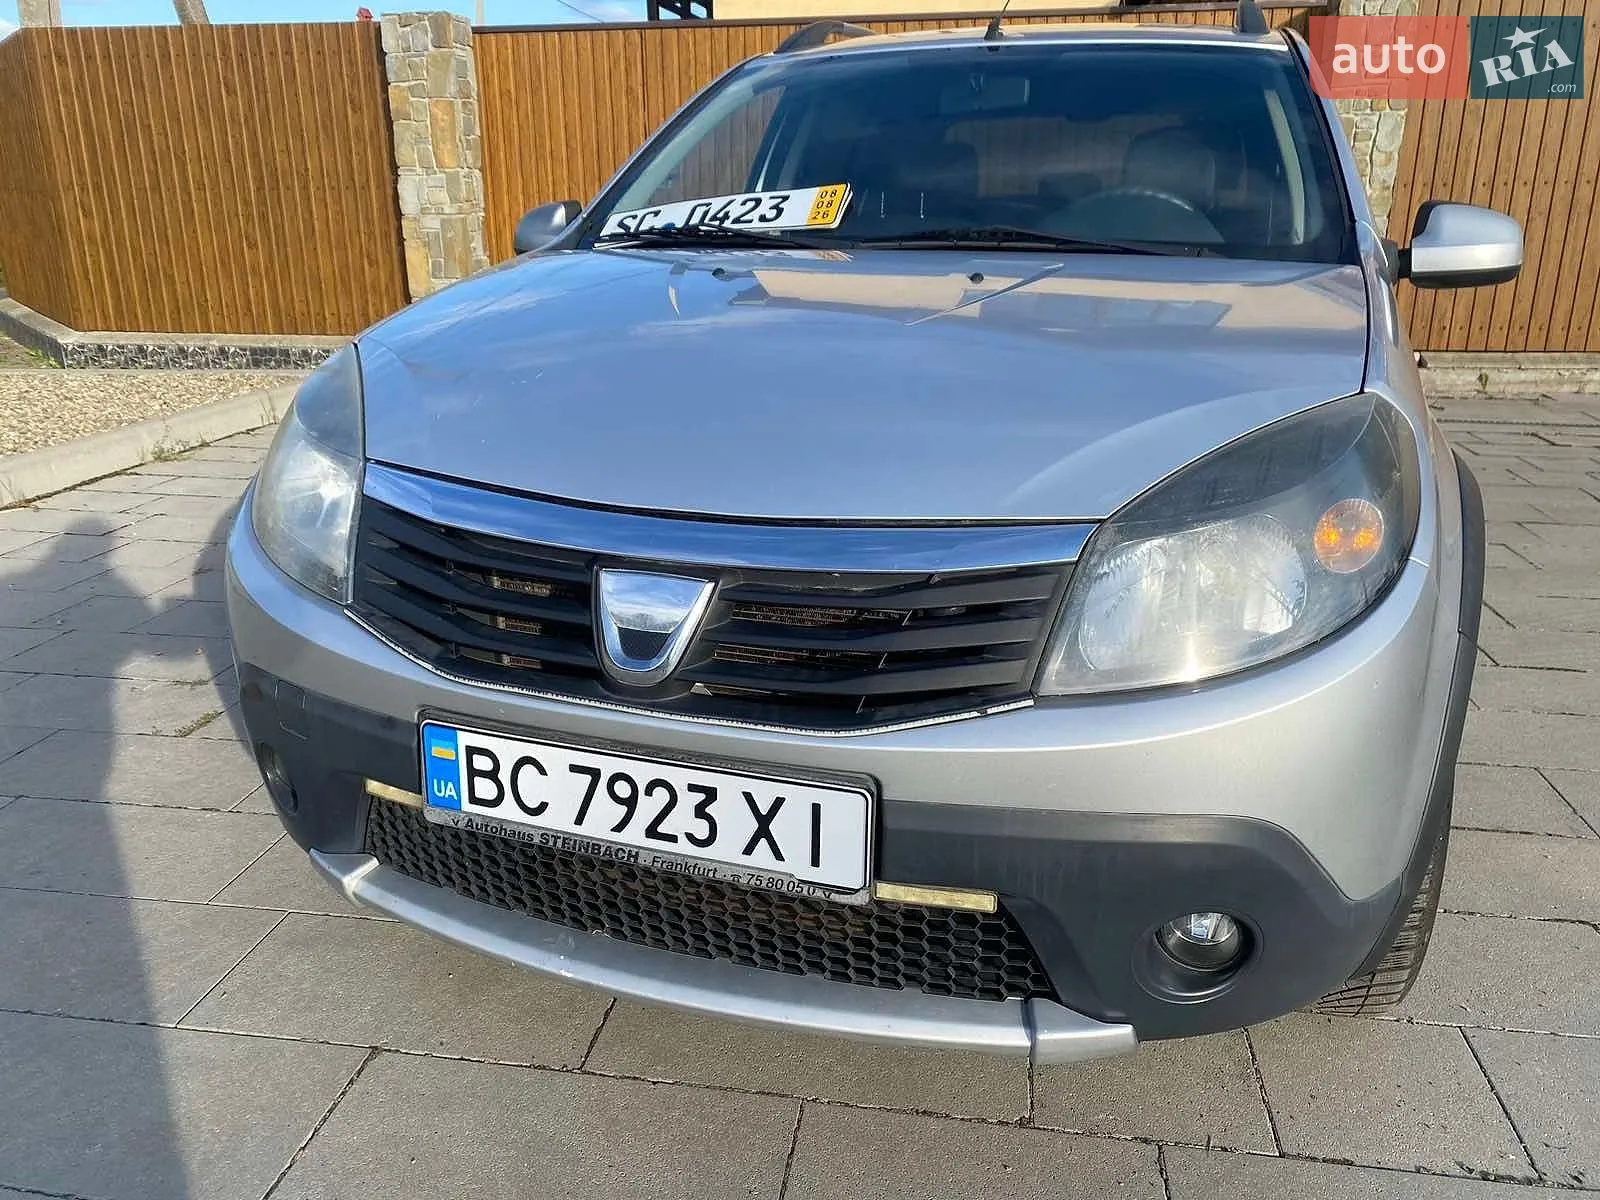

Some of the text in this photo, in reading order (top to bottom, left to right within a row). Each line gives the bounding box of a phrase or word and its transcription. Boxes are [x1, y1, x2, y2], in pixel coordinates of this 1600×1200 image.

[816, 200, 833, 209] 08
[820, 189, 837, 199] 08
[433, 778, 458, 800] UA
[464, 745, 821, 868] BC 7923 XI
[464, 817, 535, 842] Autohaus
[539, 832, 640, 864] STEINBACH
[651, 855, 719, 879] Frankfurt
[746, 873, 764, 887] 75
[766, 876, 784, 891] 80
